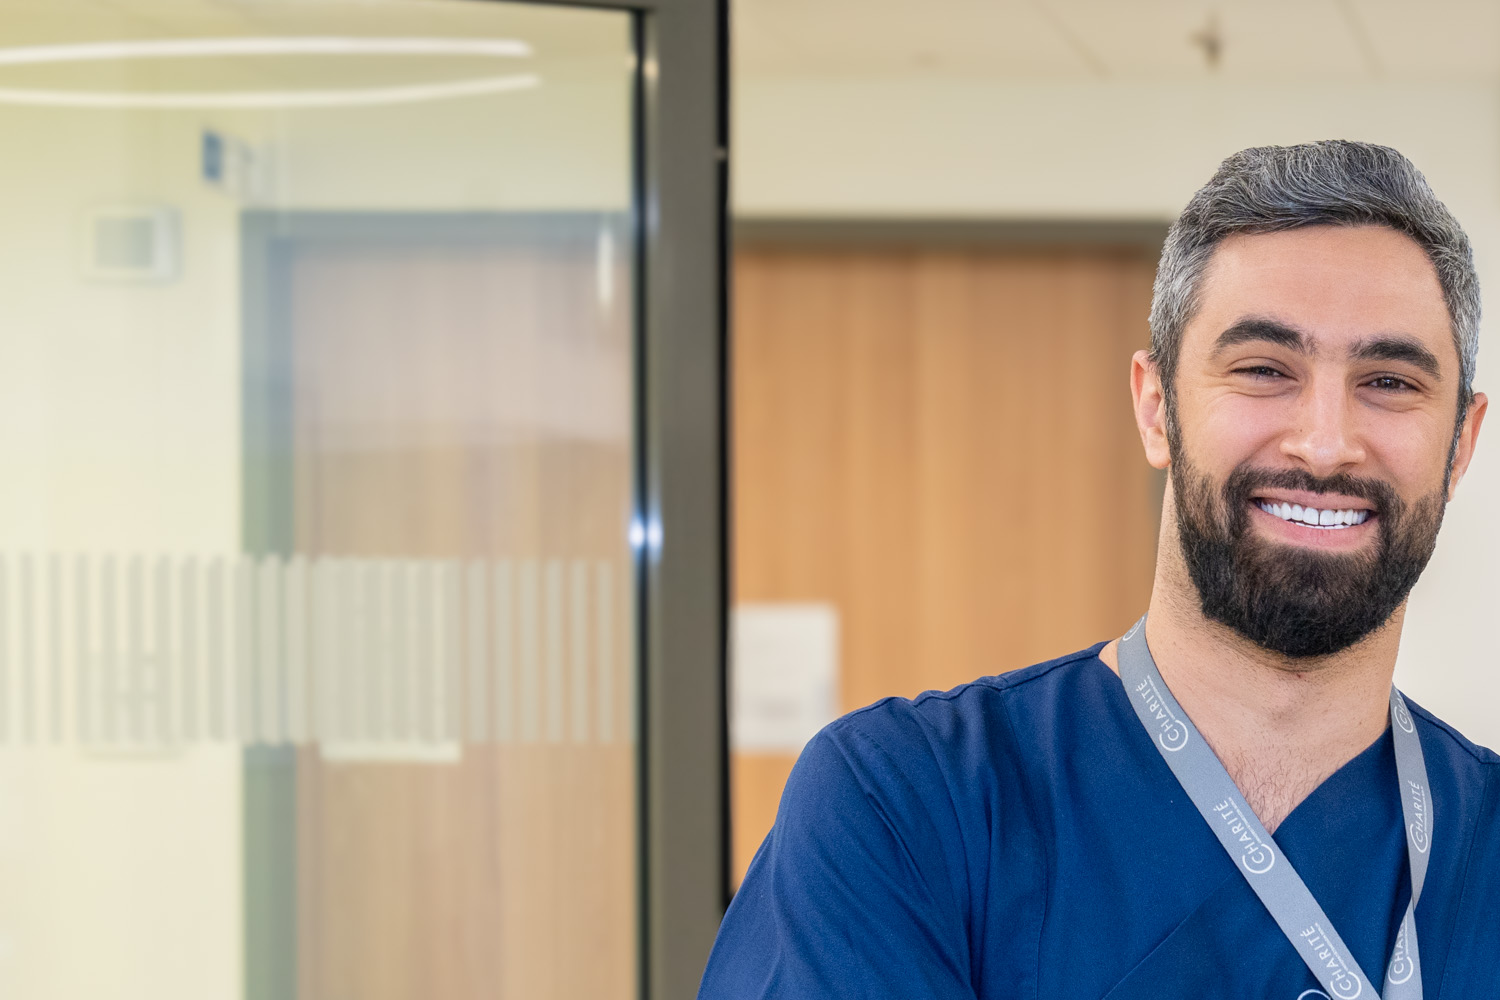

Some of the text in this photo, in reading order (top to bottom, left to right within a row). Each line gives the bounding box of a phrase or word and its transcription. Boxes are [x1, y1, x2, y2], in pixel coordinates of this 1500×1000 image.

[1135, 679, 1189, 752] CHARITÉ
[1213, 800, 1275, 874] CHARITÉ
[1300, 925, 1362, 1000] CHARITÉ
